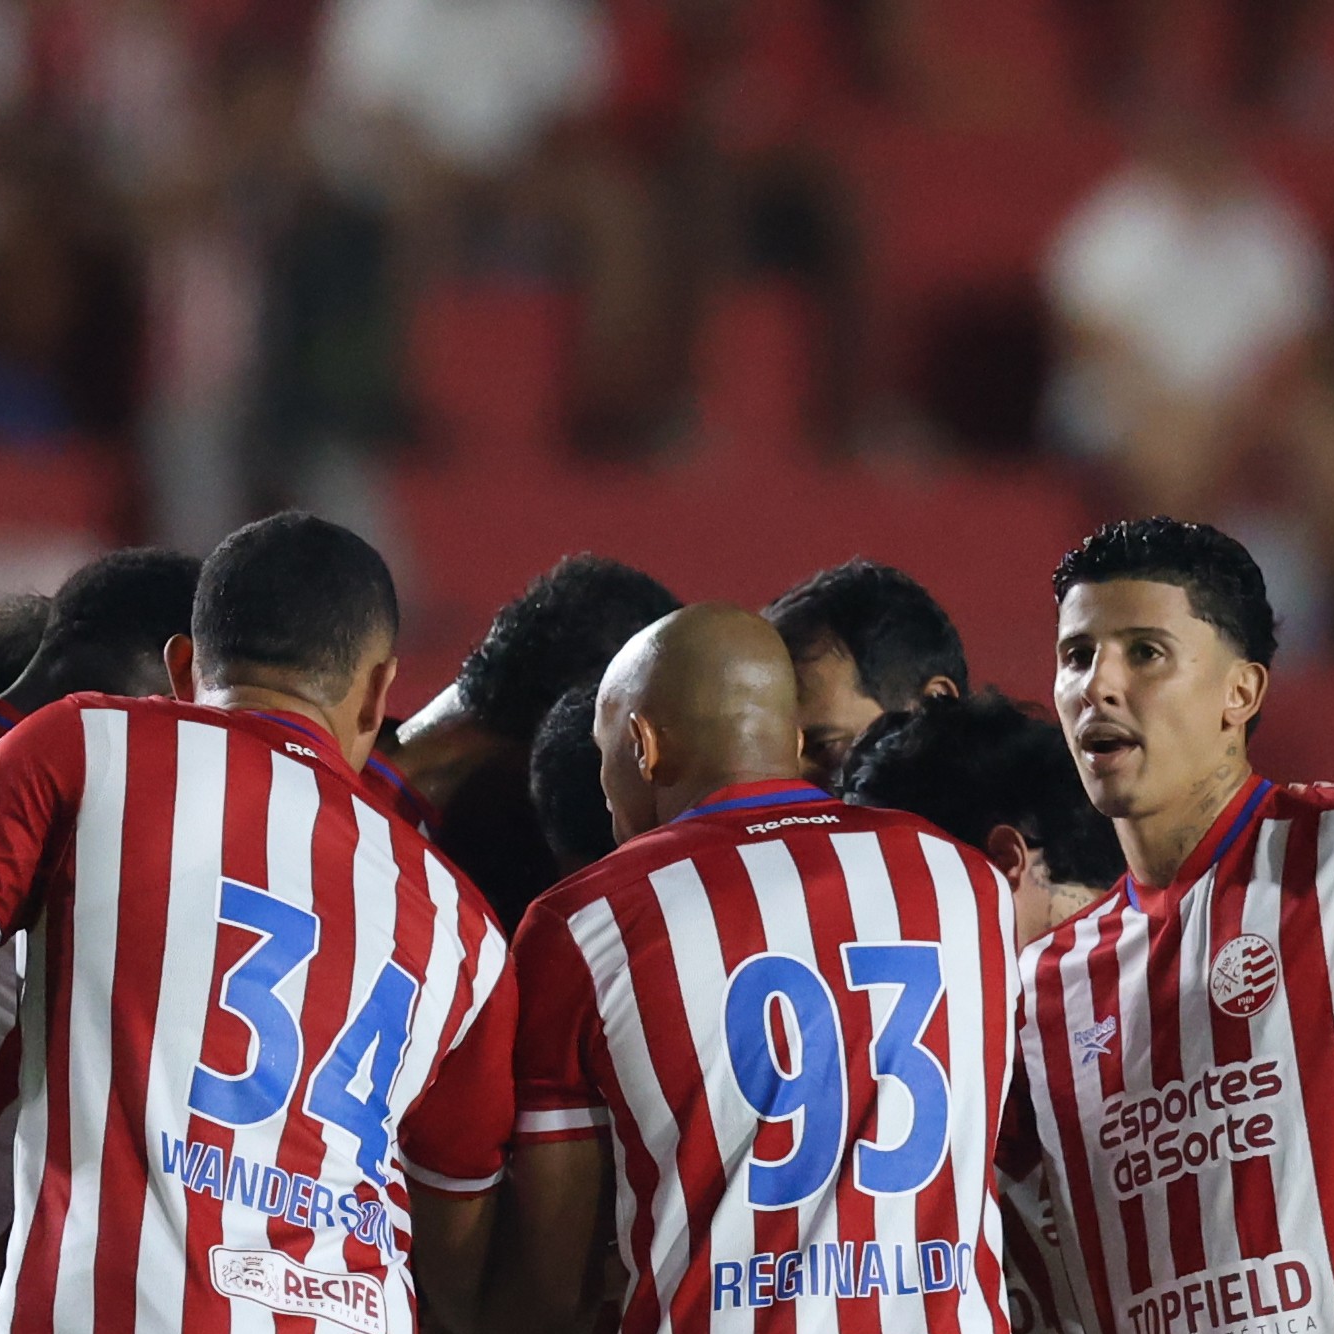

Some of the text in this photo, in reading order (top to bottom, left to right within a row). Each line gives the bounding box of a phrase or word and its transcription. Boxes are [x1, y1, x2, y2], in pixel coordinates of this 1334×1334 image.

[745, 814, 841, 835] Reebok
[187, 876, 420, 1189] 34
[724, 941, 952, 1212] 93
[1099, 1060, 1282, 1150] Esportes
[160, 1129, 394, 1260] WANDERSON
[283, 1267, 379, 1320] RECIFE
[284, 1297, 380, 1330] PREFEITURA
[712, 1238, 972, 1313] REGINALDO
